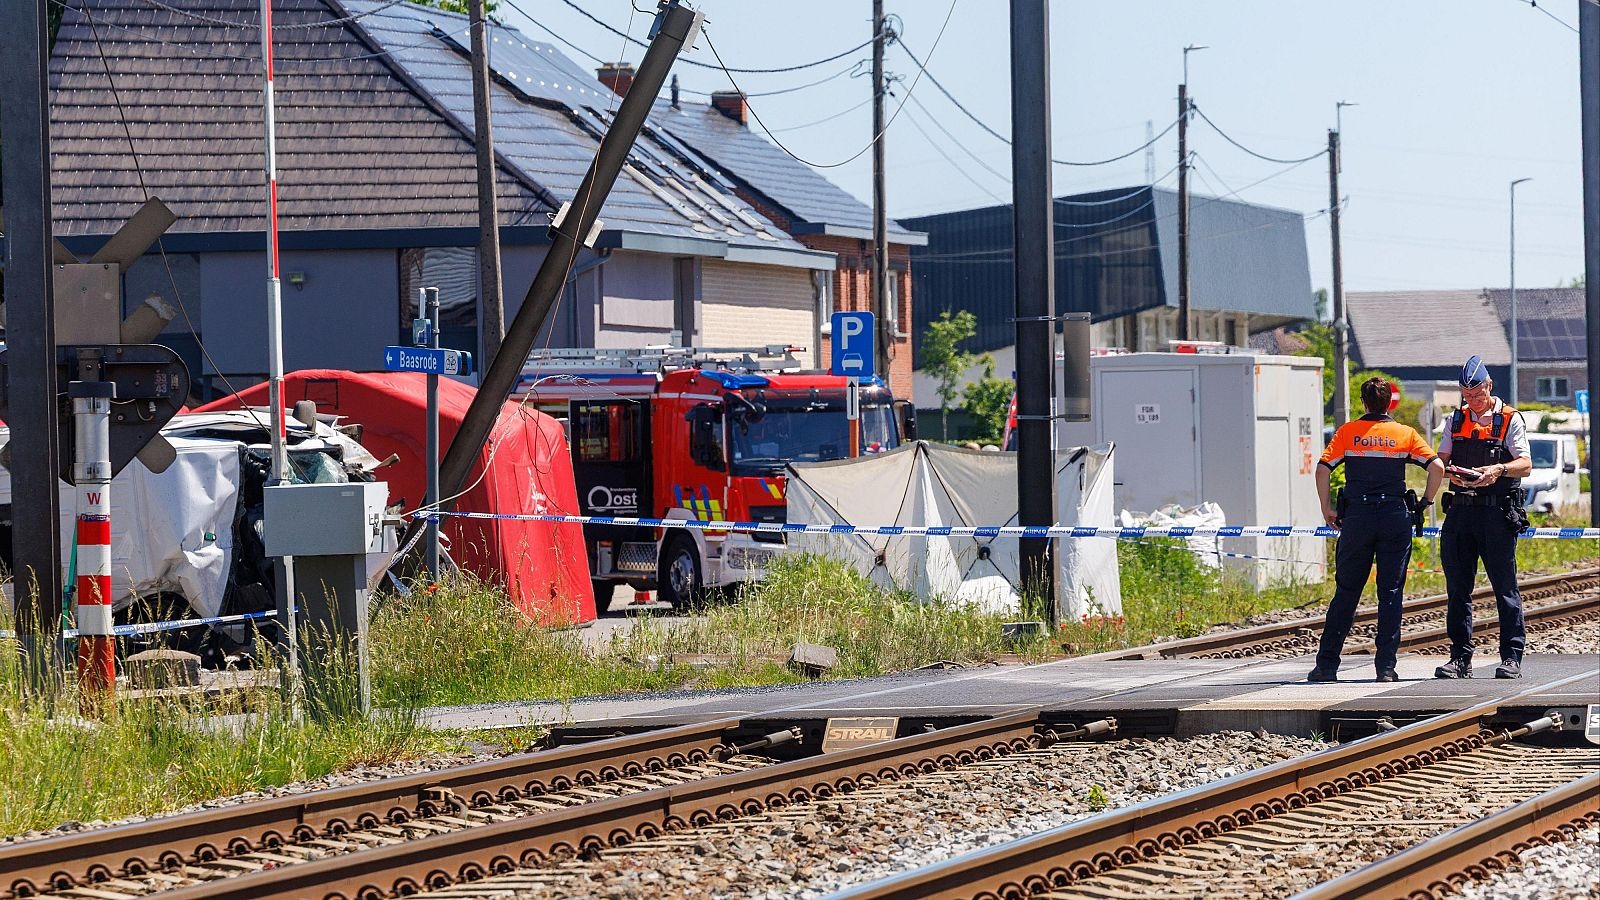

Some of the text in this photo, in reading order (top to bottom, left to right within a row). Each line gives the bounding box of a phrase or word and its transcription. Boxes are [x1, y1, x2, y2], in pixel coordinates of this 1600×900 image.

[842, 316, 864, 349] P
[400, 350, 437, 370] Baasrode
[1354, 435, 1396, 447] Politie
[87, 492, 101, 505] W
[588, 485, 637, 512] Oost
[827, 728, 892, 740] STRAIL
